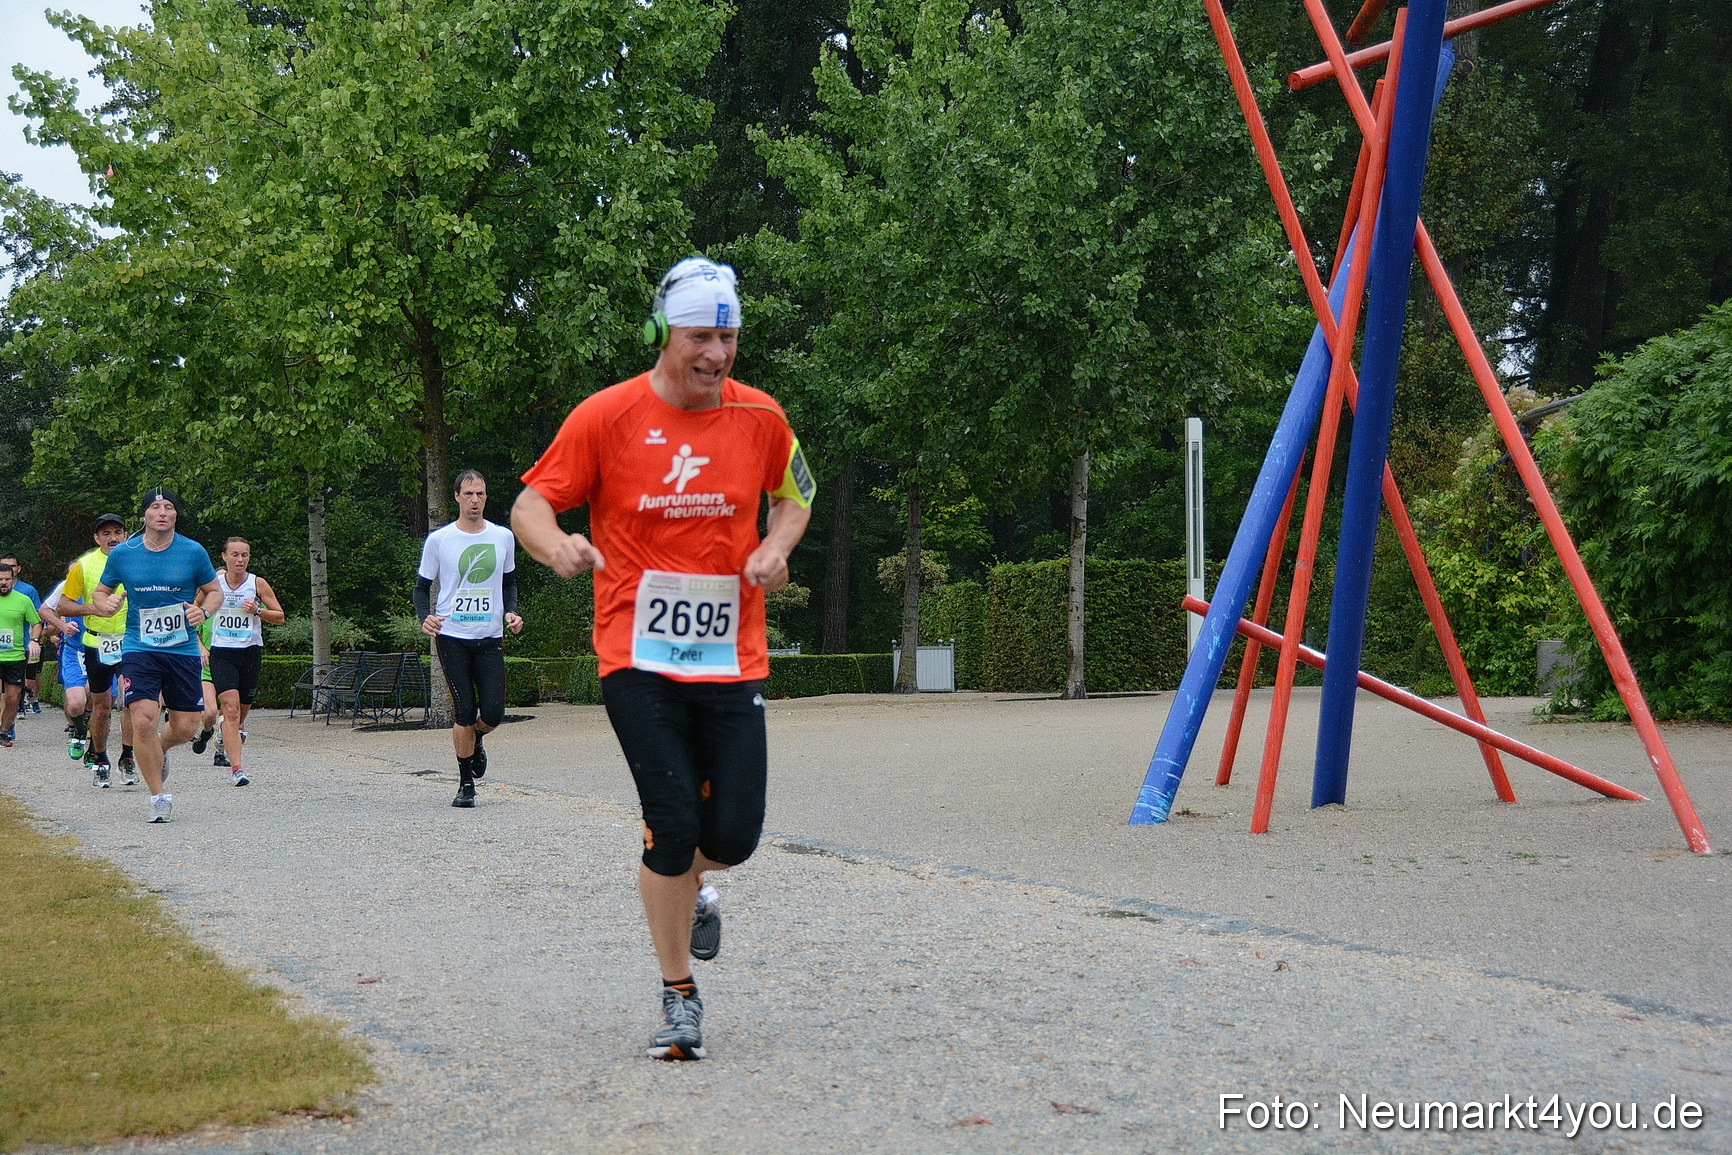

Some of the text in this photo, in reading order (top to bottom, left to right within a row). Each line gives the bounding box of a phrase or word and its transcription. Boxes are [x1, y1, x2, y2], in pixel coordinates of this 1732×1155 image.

[638, 492, 725, 512] funrunners
[664, 503, 736, 519] neumarkt
[456, 597, 490, 612] 2715
[145, 614, 181, 634] 2490
[219, 615, 250, 629] 2004
[648, 598, 731, 638] 2695
[153, 634, 177, 644] Stephan
[670, 646, 703, 661] Peter
